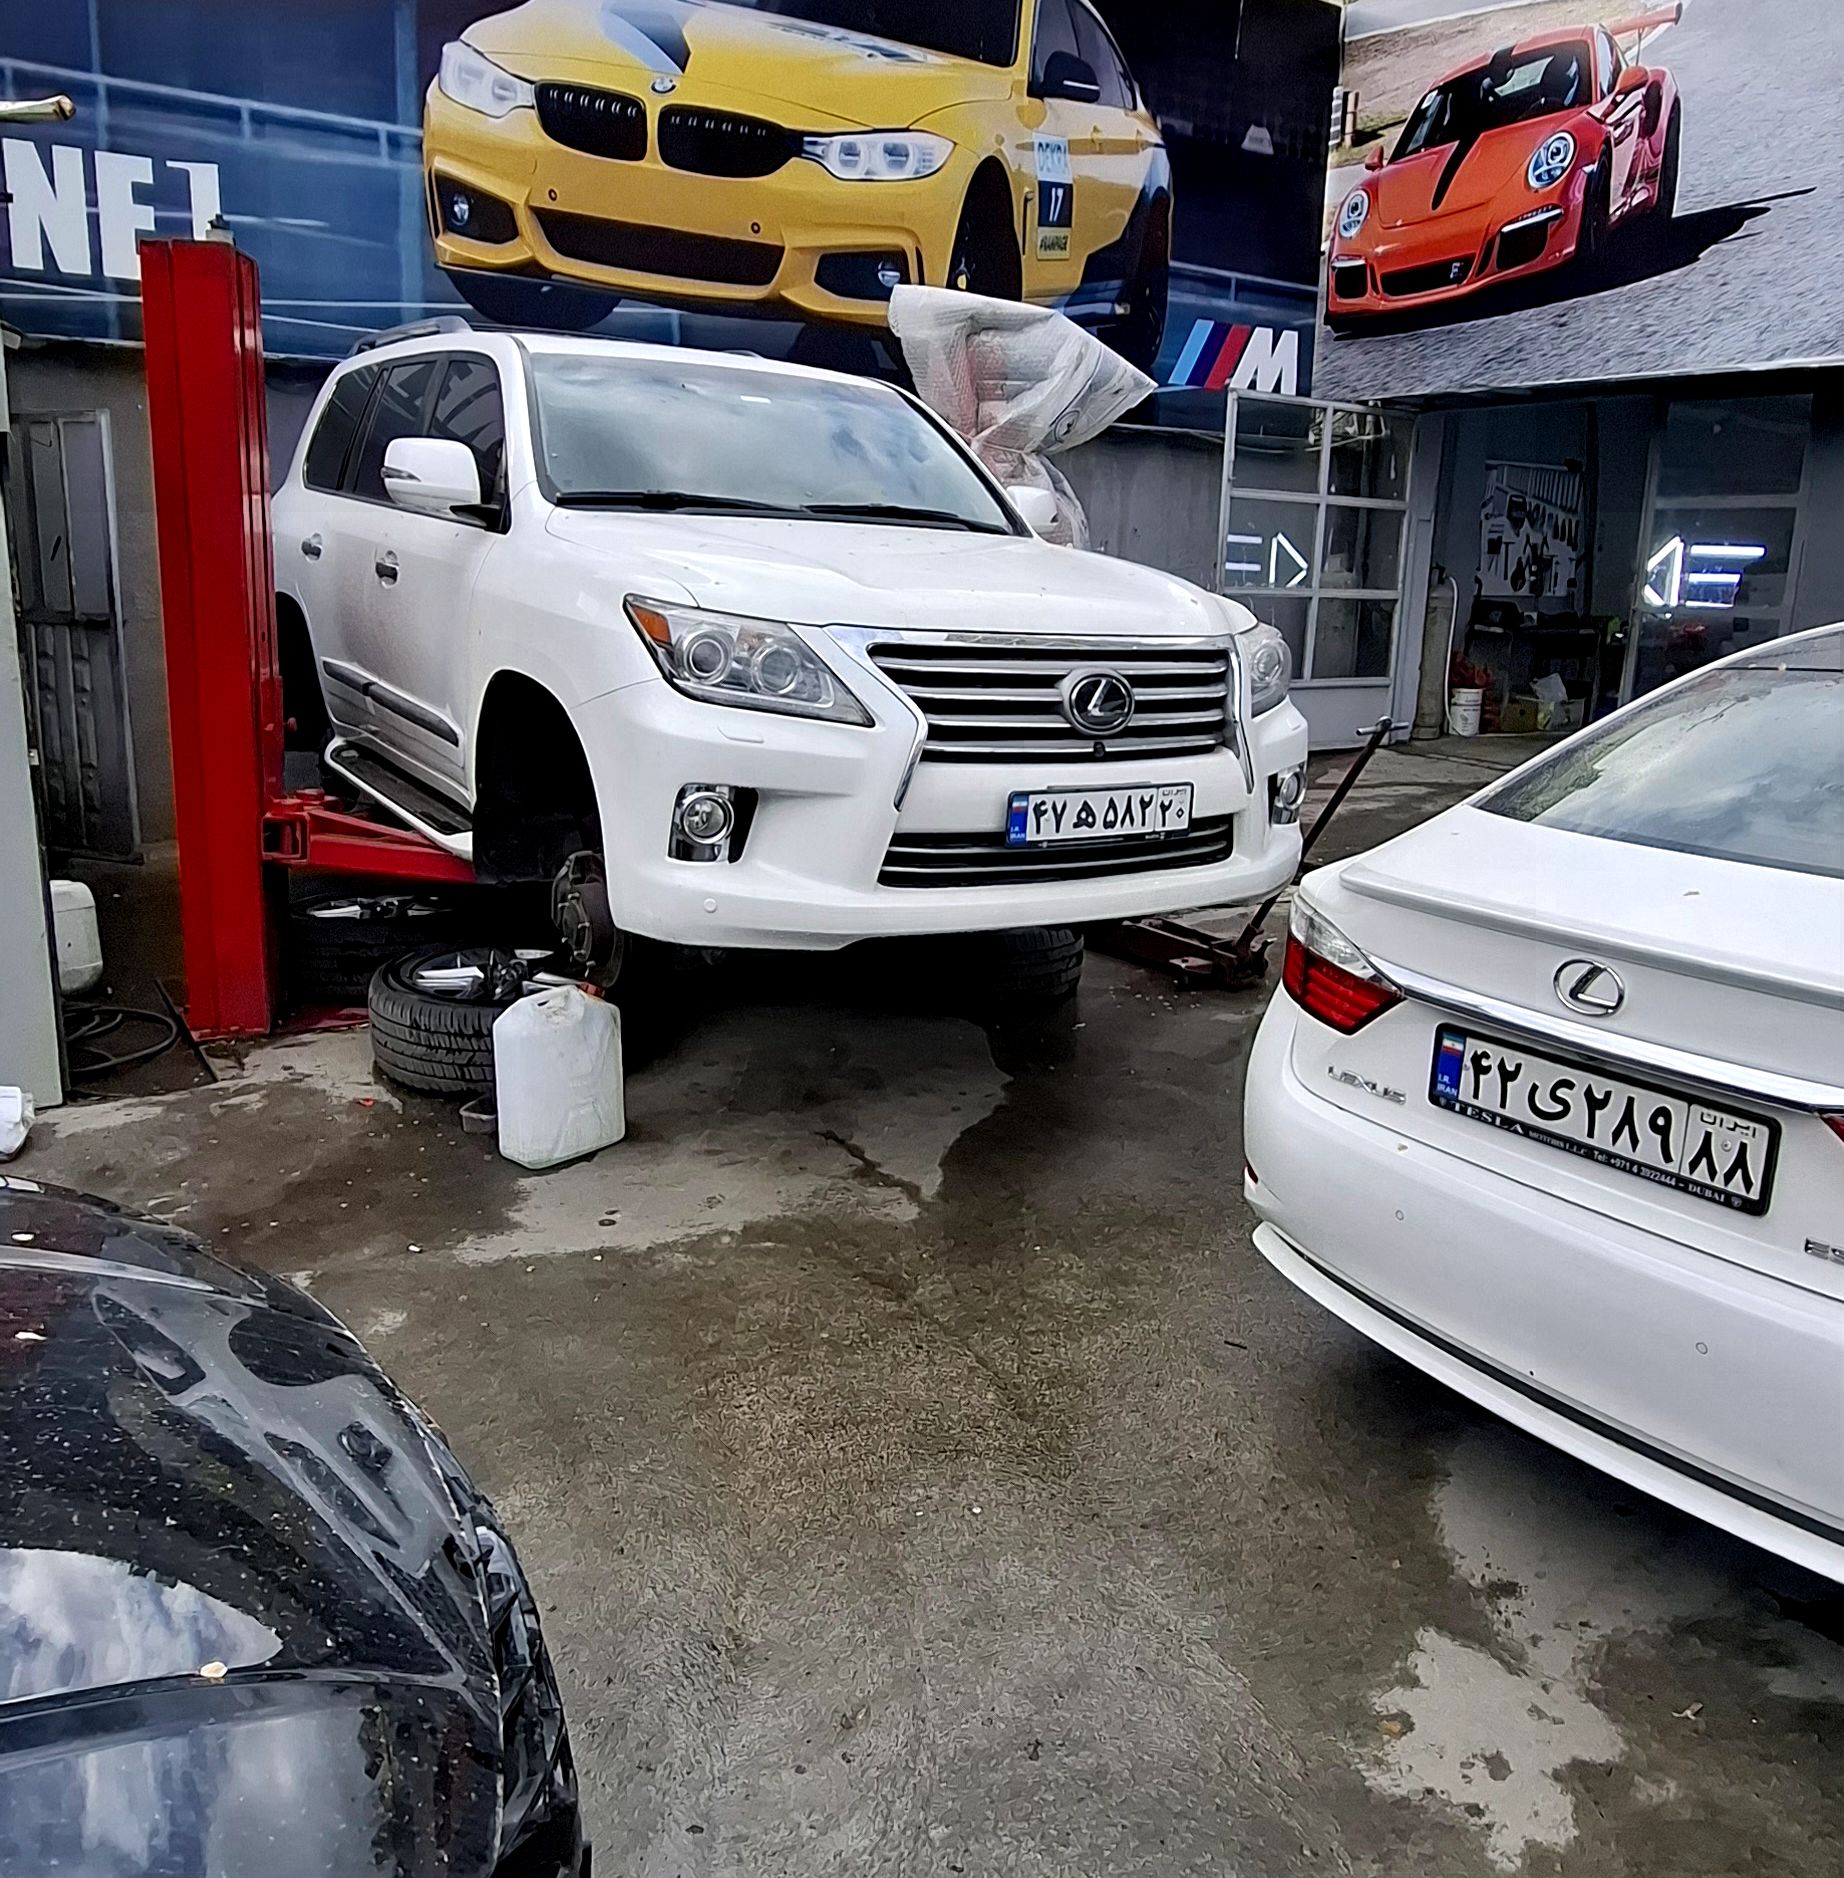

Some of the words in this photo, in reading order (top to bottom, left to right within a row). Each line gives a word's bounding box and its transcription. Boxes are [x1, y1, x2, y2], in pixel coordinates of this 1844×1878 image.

[1049, 187, 1064, 222] 17
[1436, 1083, 1459, 1097] IRAN
[1450, 1101, 1525, 1136] TESLA
[1610, 1157, 1630, 1172] +971
[1688, 1183, 1725, 1202] DUBAI
